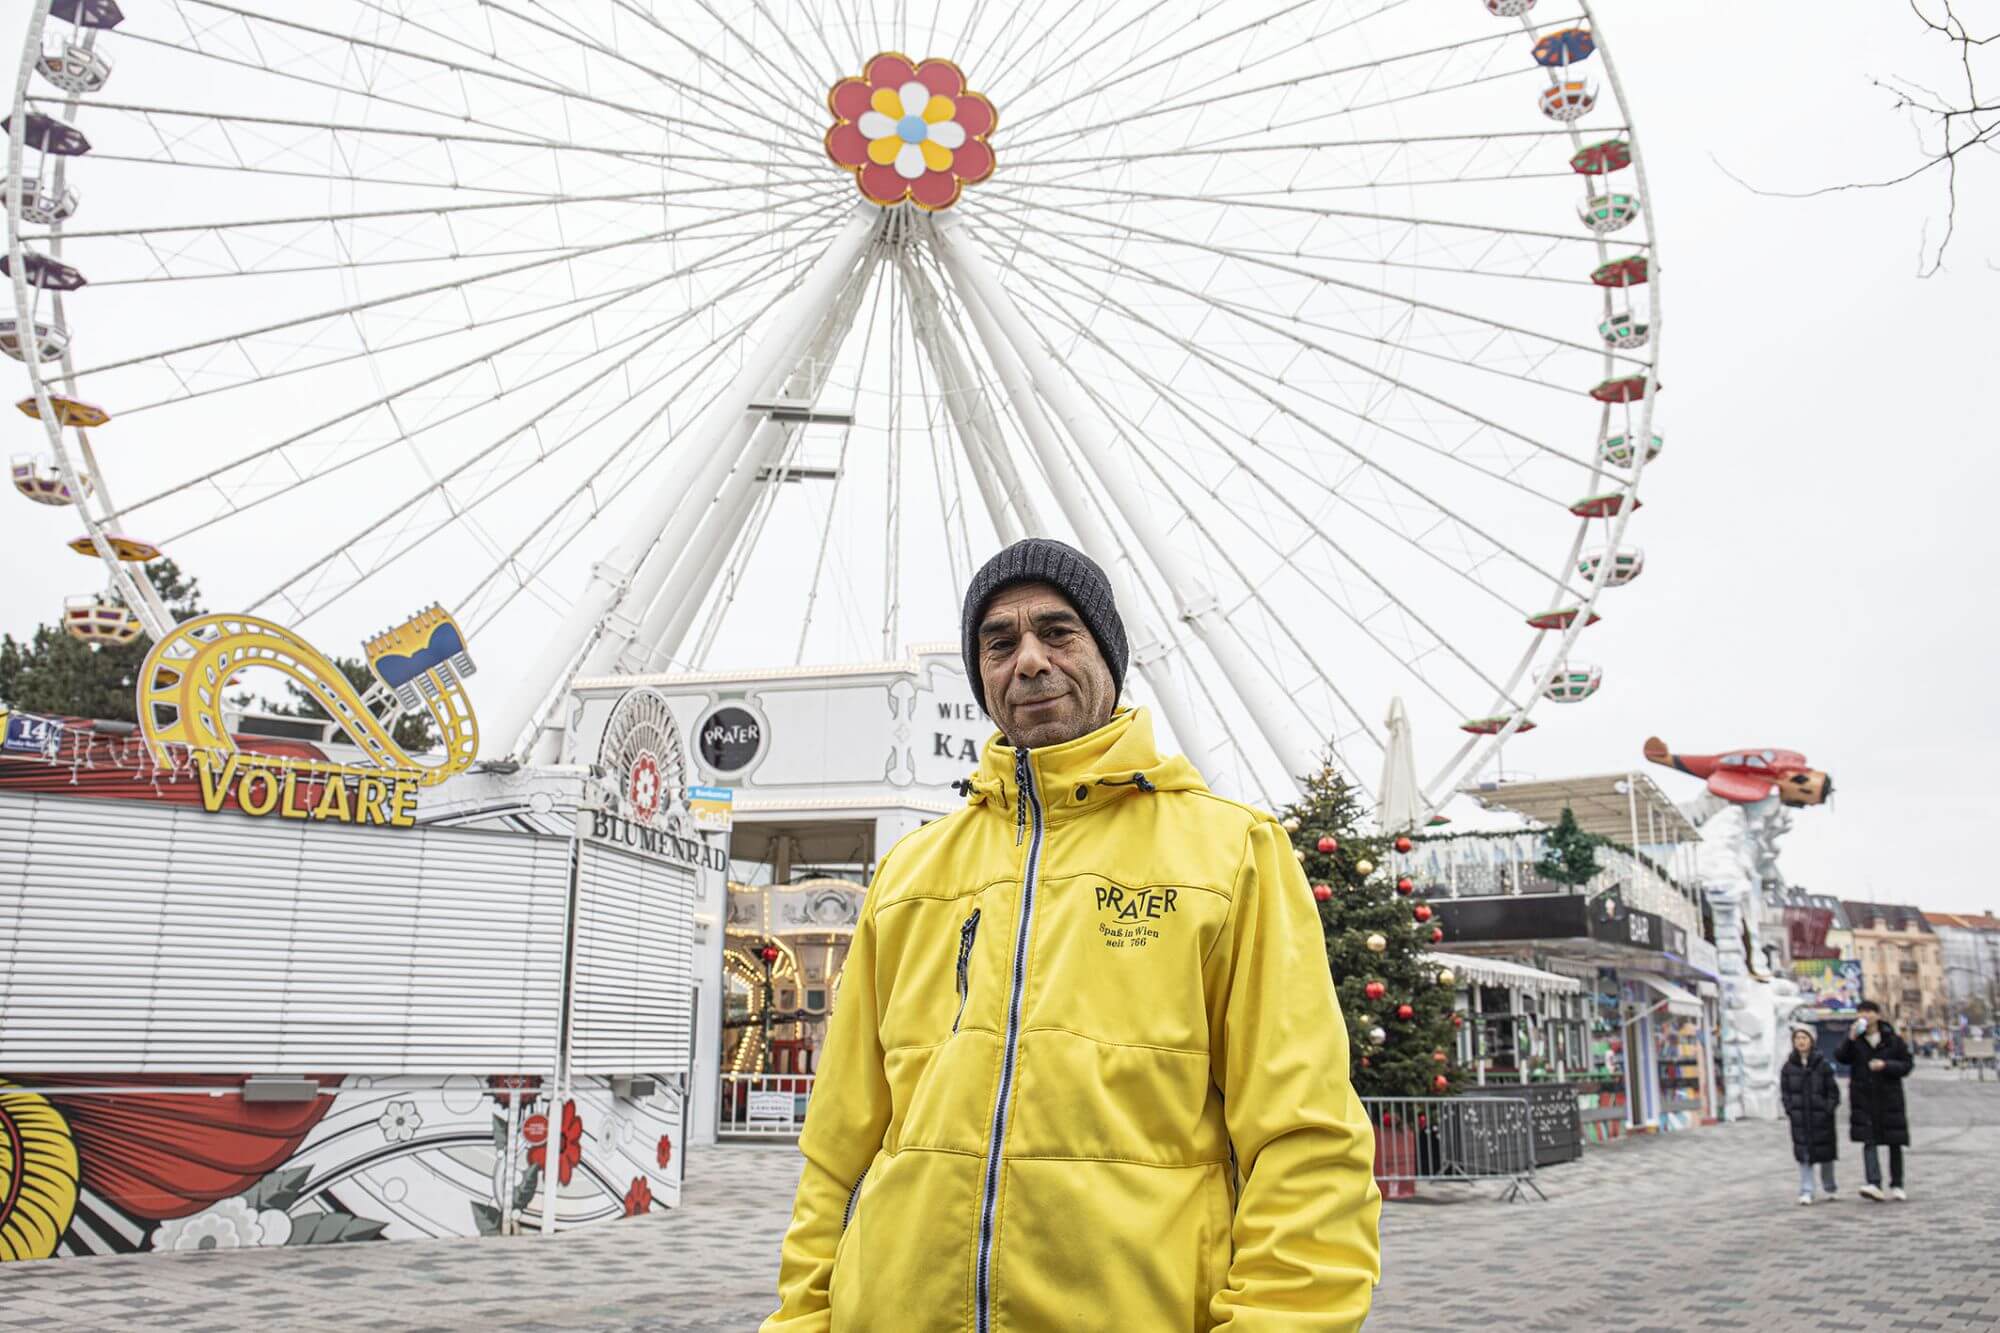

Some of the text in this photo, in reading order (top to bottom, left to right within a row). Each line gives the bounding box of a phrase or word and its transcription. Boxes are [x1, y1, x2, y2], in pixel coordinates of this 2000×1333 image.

[18, 720, 48, 740] 14
[704, 725, 759, 745] PRATER
[933, 732, 979, 763] KA
[191, 749, 420, 828] VOLARE
[592, 810, 727, 872] BLUMENRAD
[1095, 886, 1178, 919] PRATER
[1098, 922, 1159, 938] Spaß in Wien
[1105, 938, 1125, 947] seit
[1628, 912, 1650, 945] BAR
